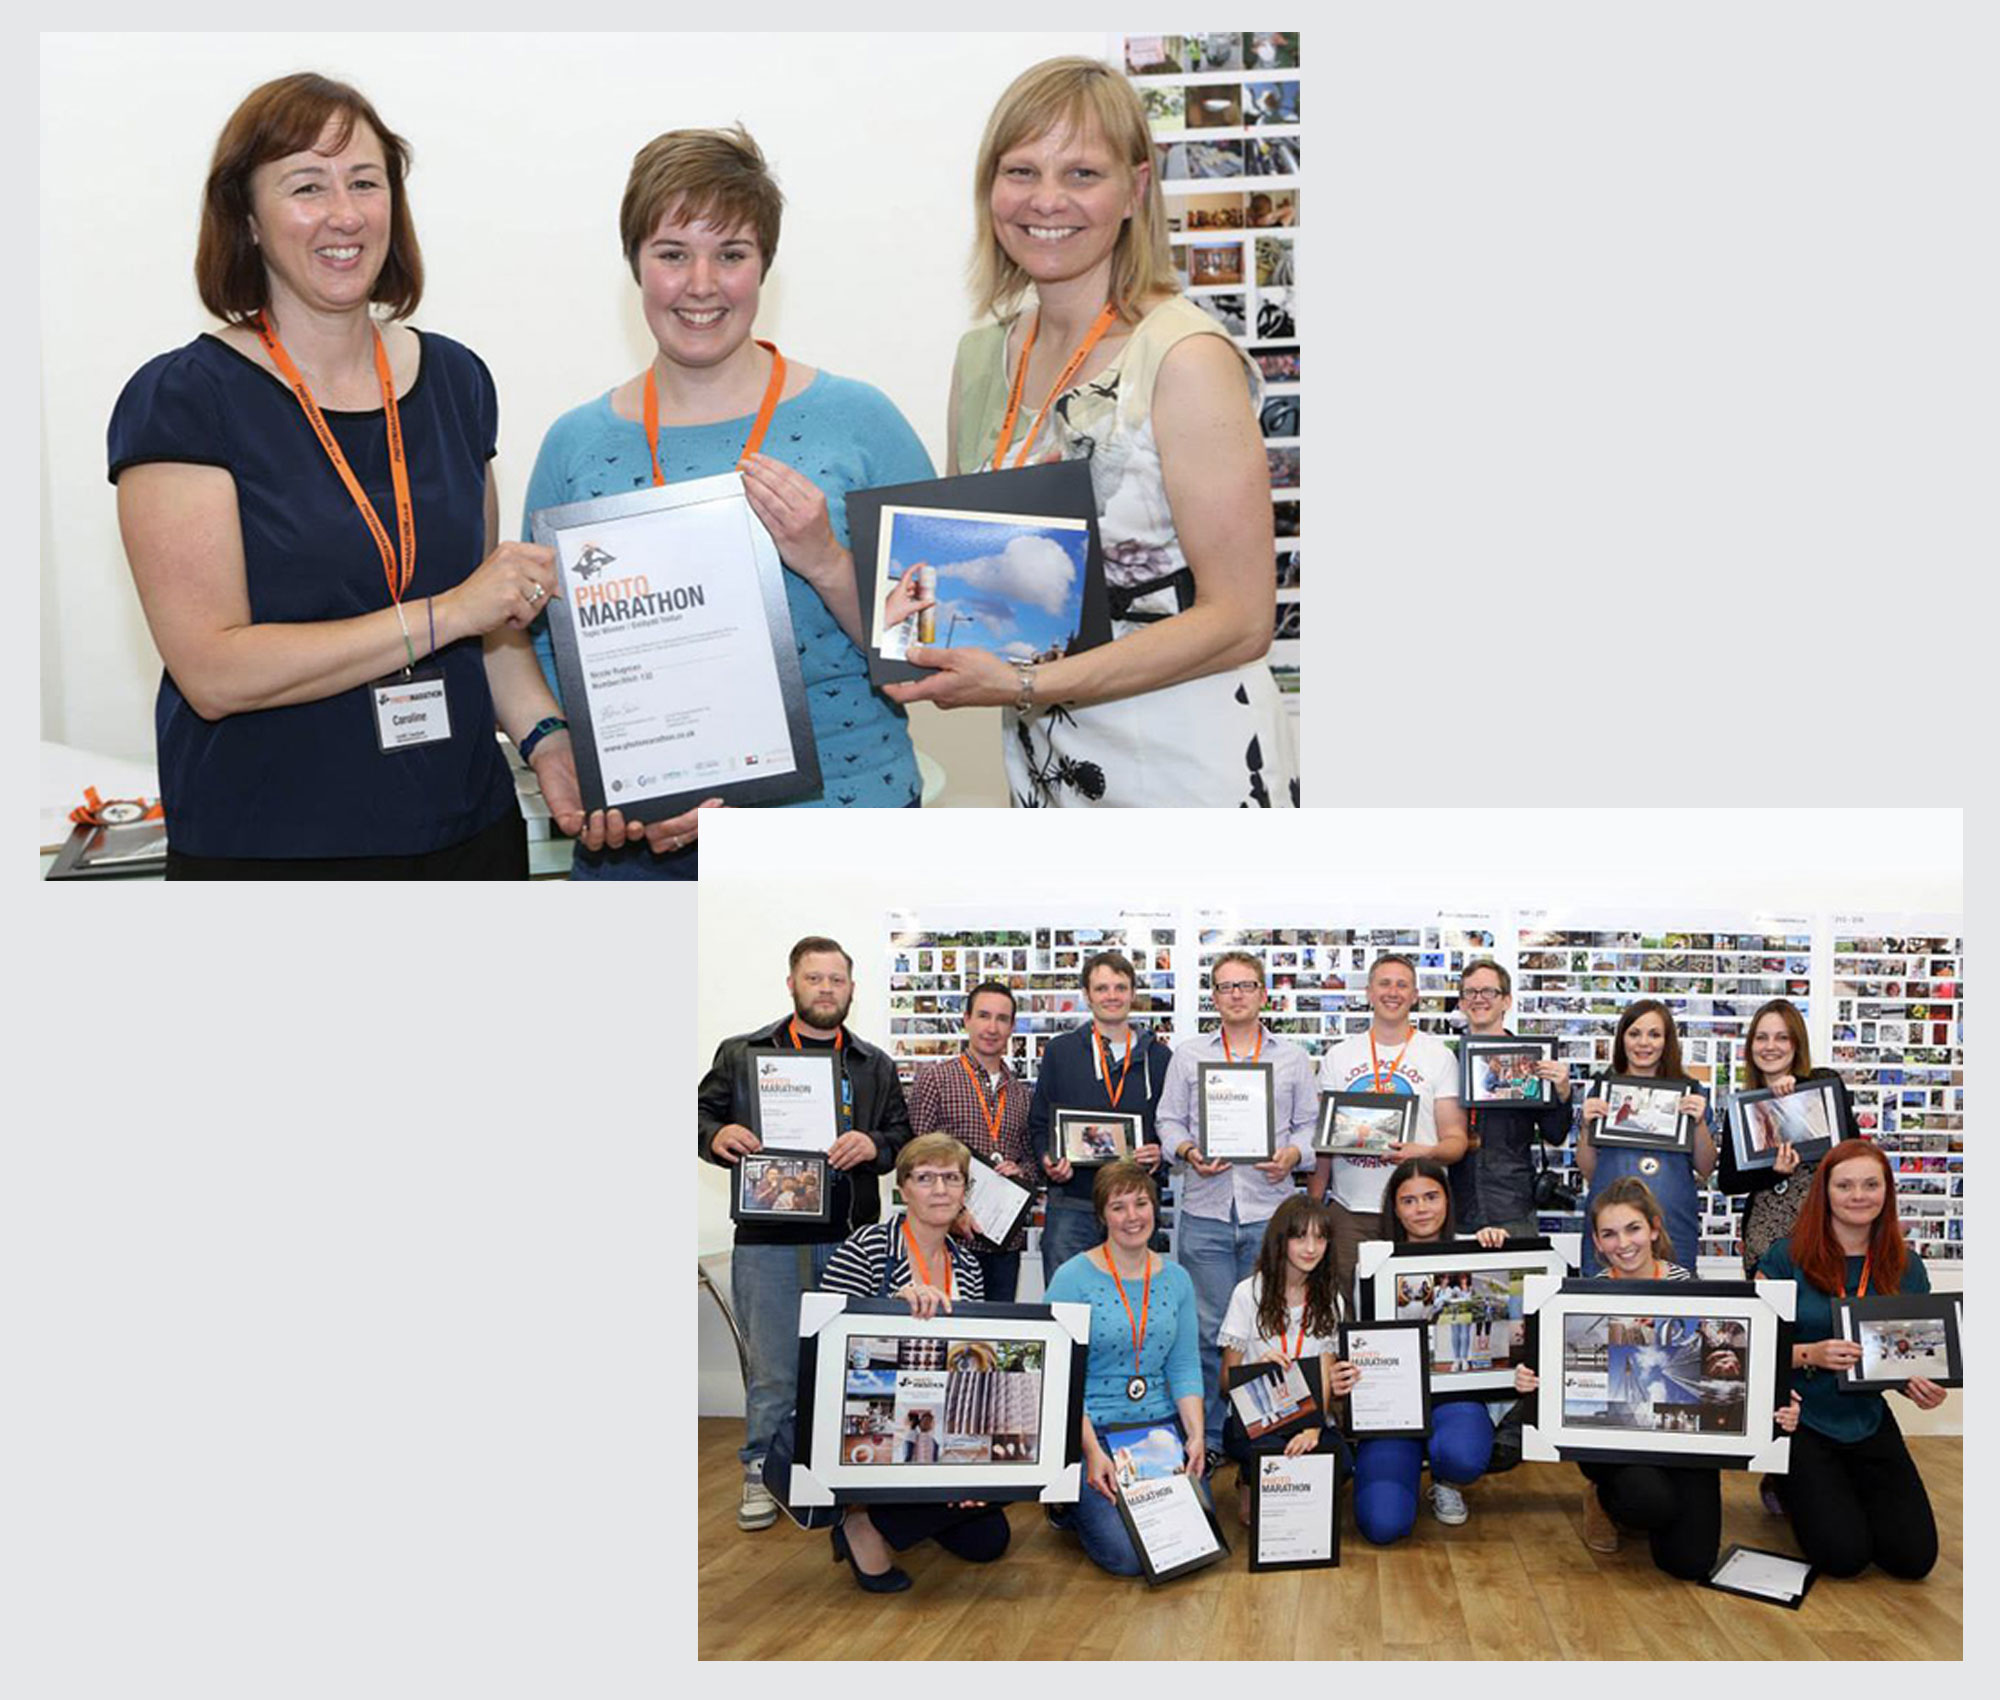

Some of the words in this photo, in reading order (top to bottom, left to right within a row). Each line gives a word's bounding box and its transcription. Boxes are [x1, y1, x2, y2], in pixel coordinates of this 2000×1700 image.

[575, 575, 649, 608] PHOTO
[578, 585, 705, 628] MARATHON
[392, 712, 427, 726] Caroline
[1345, 1062, 1369, 1083] LOS
[1378, 1059, 1425, 1083] POLOS
[760, 1084, 812, 1094] MARATHON
[1352, 1357, 1400, 1367] MARATHON
[1128, 1486, 1174, 1506] MARATHON
[1262, 1482, 1312, 1493] MARATHON
